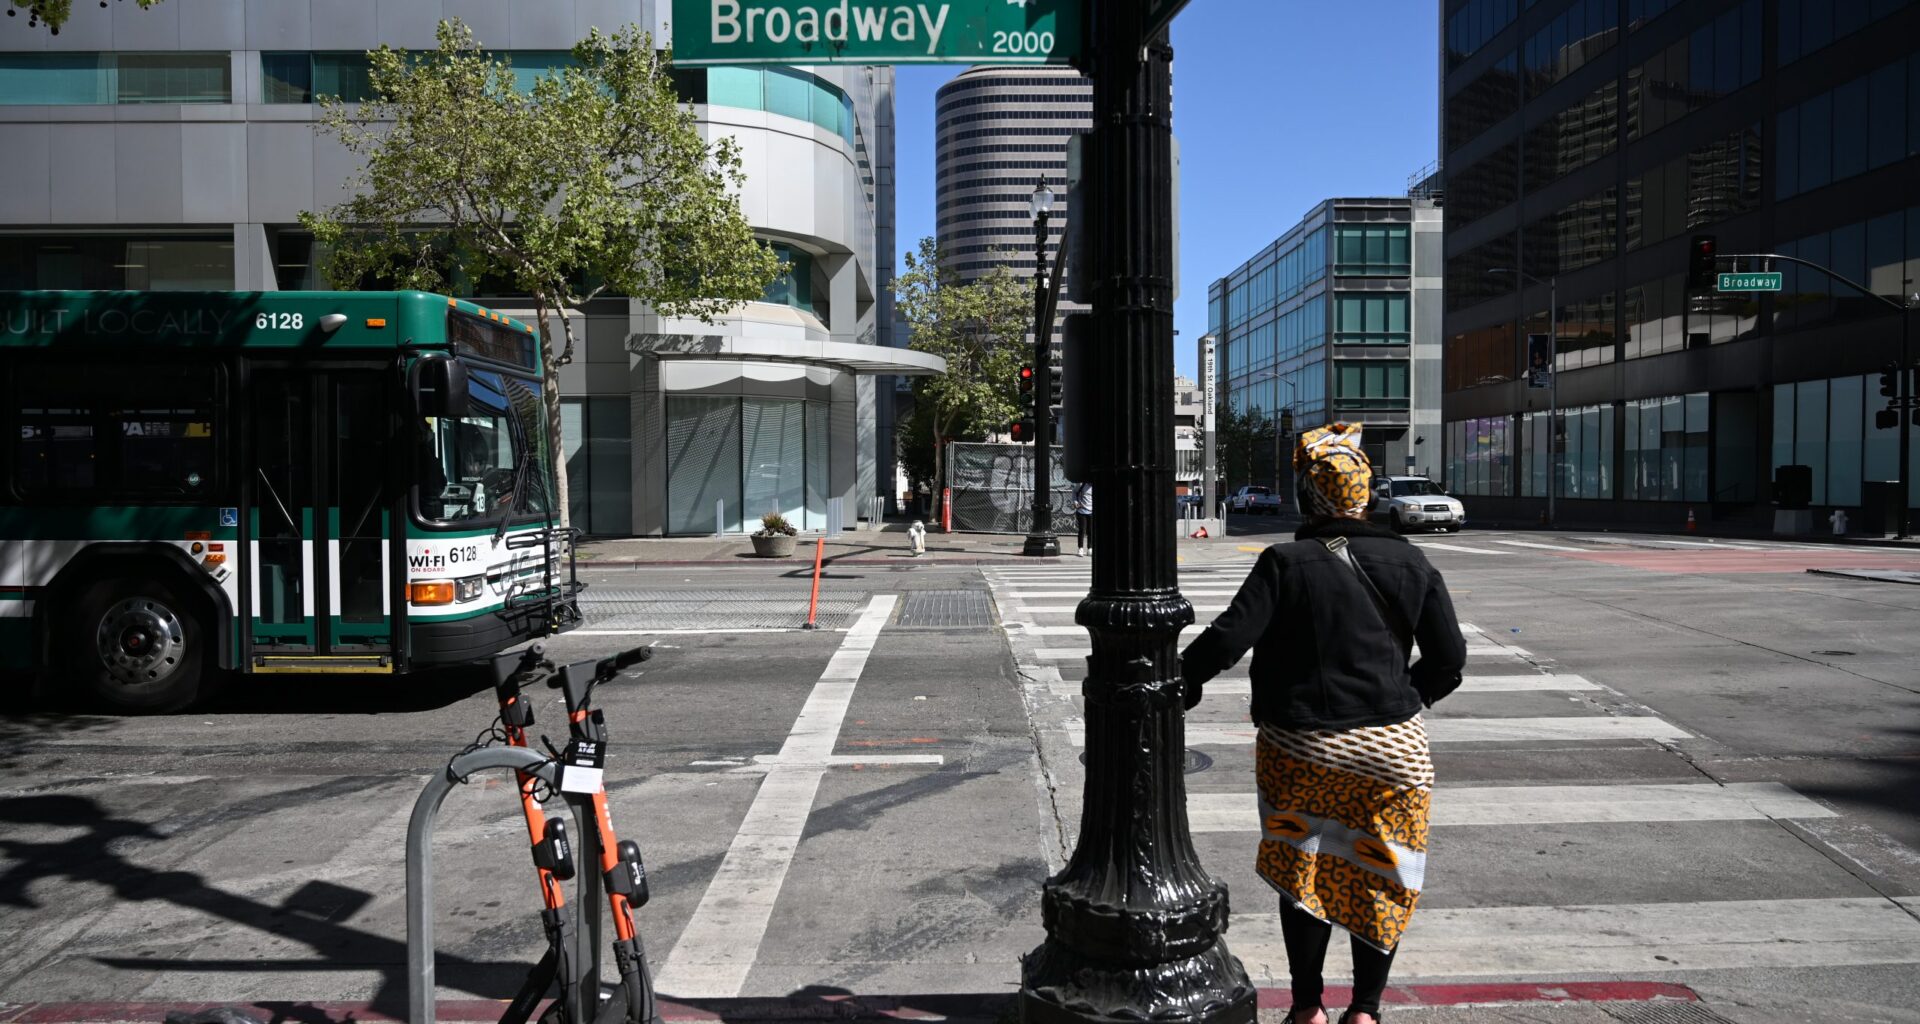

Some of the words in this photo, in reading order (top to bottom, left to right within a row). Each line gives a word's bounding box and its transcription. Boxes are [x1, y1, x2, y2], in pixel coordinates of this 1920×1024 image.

[711, 0, 949, 54] Broadway
[993, 31, 1054, 53] 2000
[1723, 277, 1777, 288] Broadway
[84, 308, 231, 335] LOCALLY
[255, 312, 304, 331] 6128
[1207, 374, 1214, 382] St
[449, 545, 477, 564] 6128
